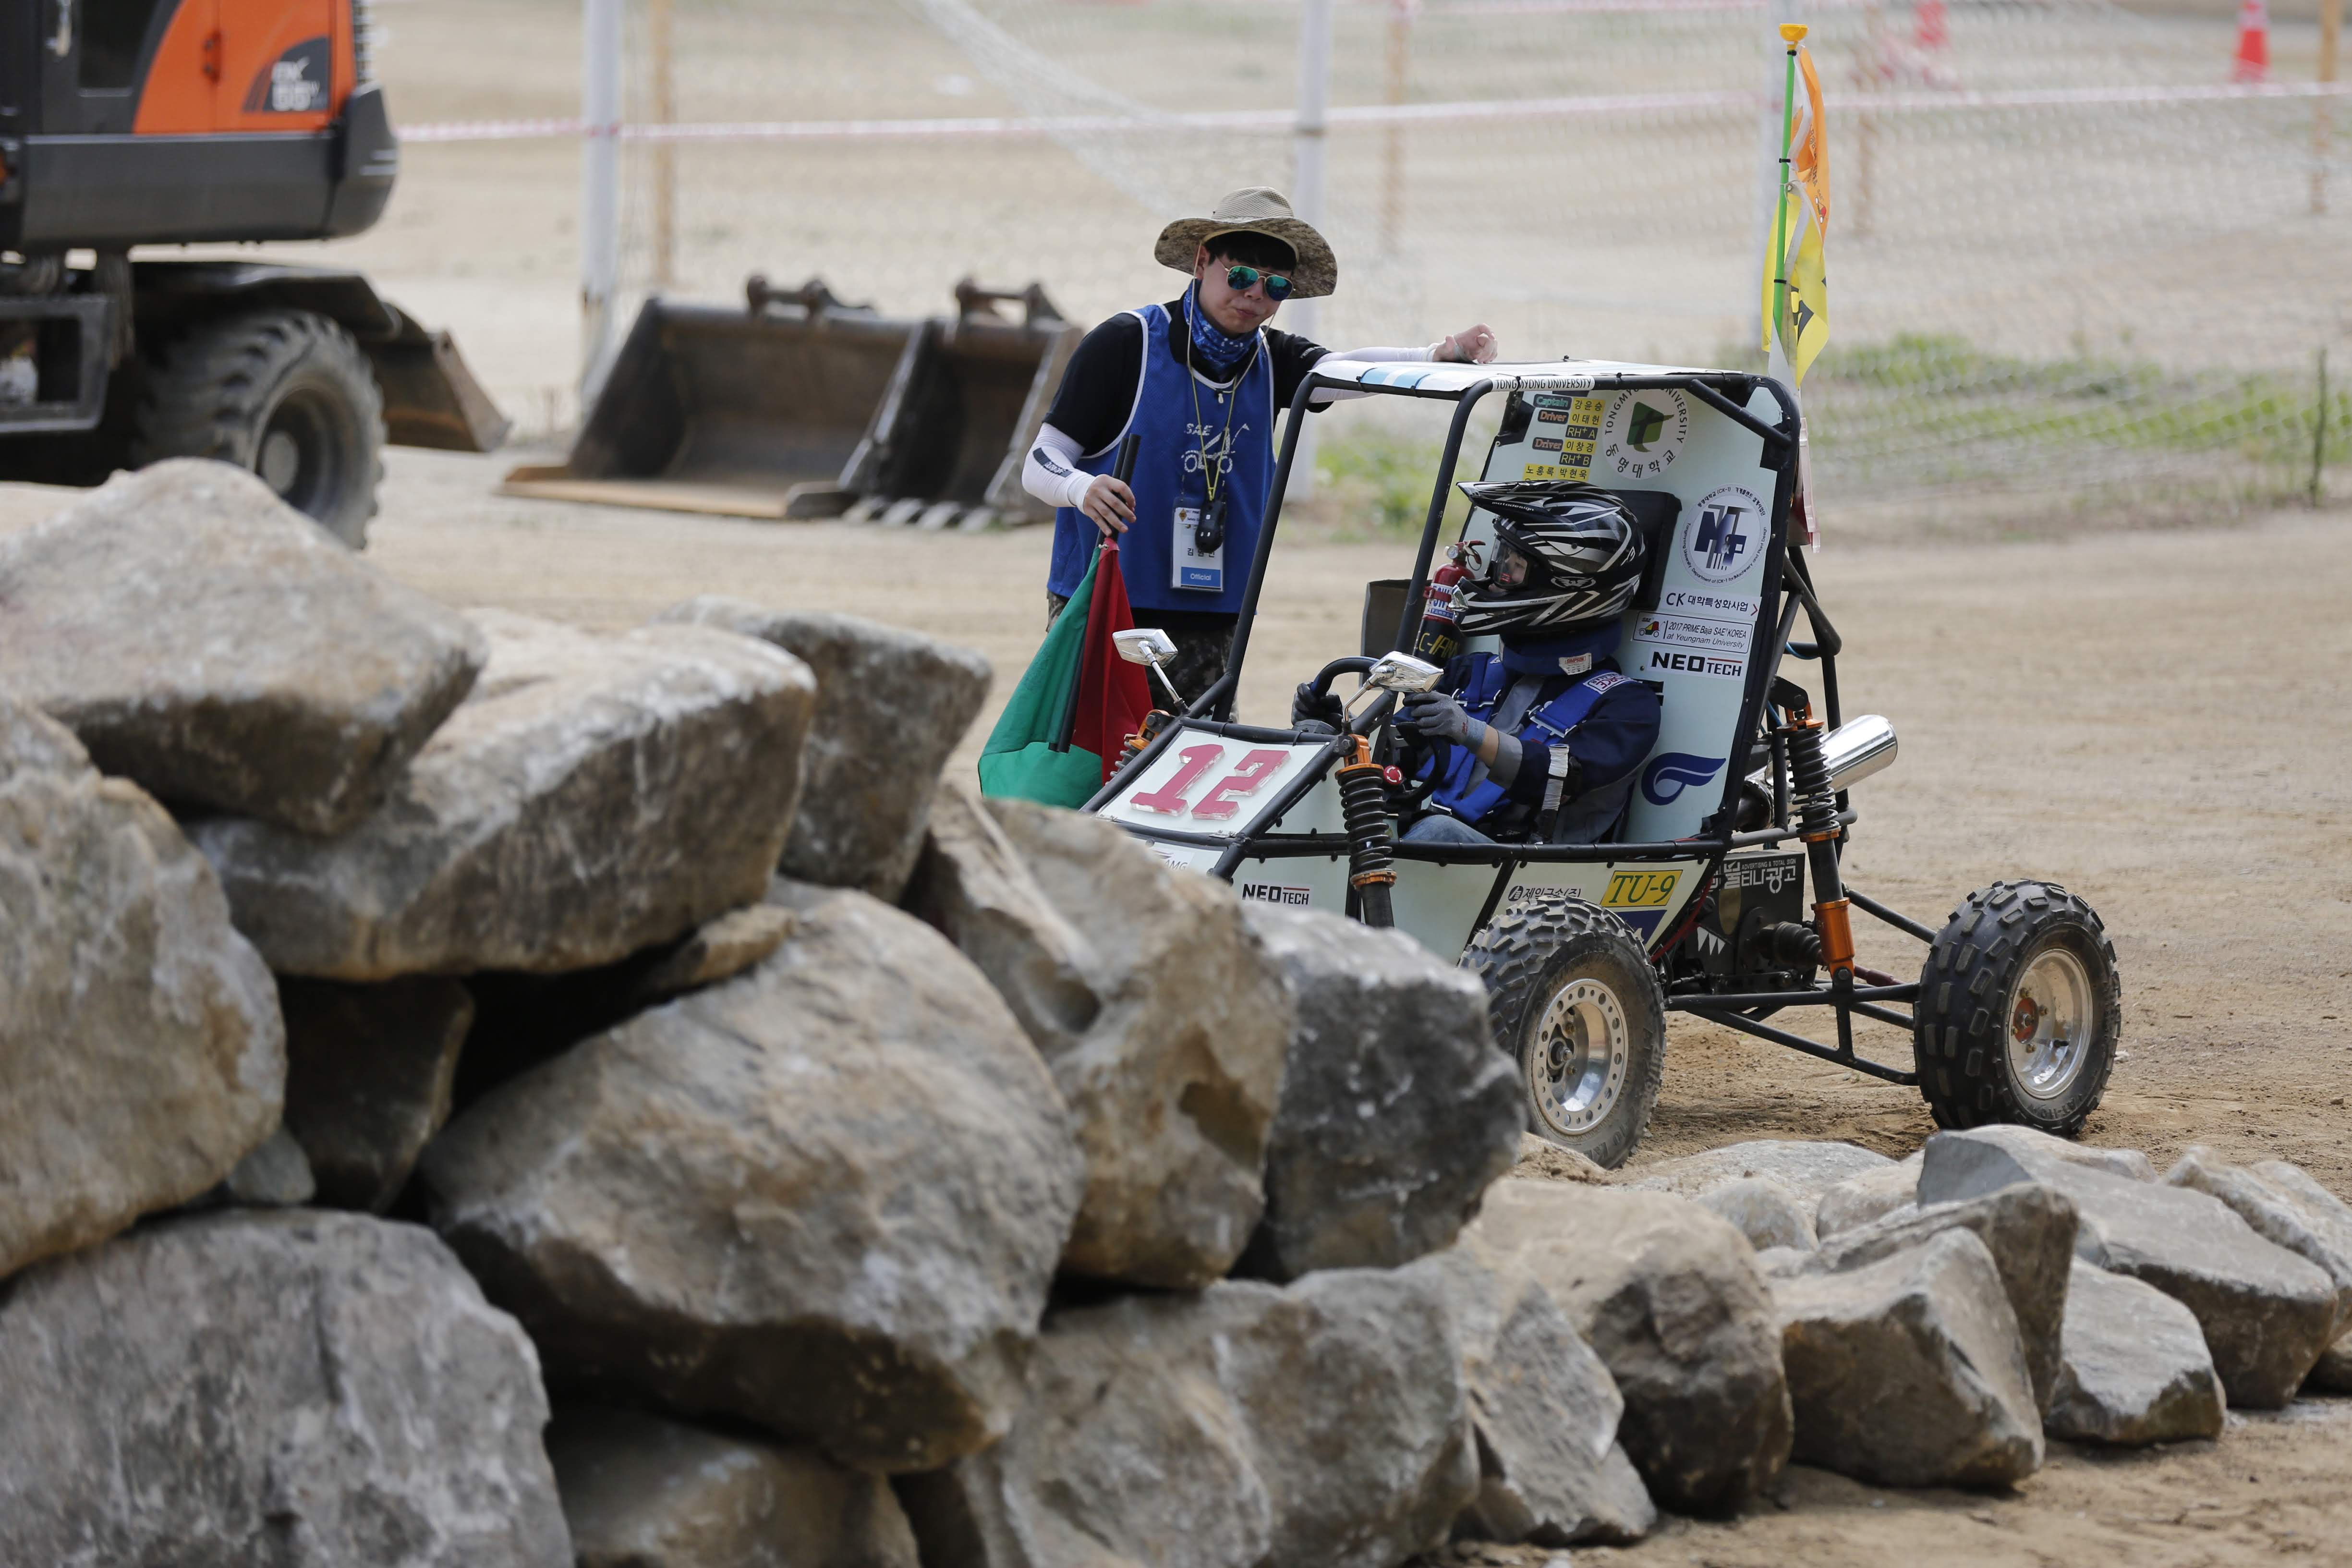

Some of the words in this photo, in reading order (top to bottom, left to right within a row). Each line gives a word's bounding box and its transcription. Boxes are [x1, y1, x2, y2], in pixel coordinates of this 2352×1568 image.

[1496, 378, 1545, 389] TONGMYONG
[1548, 378, 1591, 389] UNIVERSITY
[1536, 396, 1569, 408] Captain
[1540, 411, 1567, 422] Driver
[1661, 388, 1687, 443] NIVERSITY
[1186, 423, 1213, 436] SAE
[1588, 430, 1596, 439] A
[1535, 438, 1562, 450] Driver
[1583, 456, 1589, 465] B
[1606, 443, 1676, 478] 동명대학교
[1492, 501, 1534, 512] motodesign
[1190, 573, 1212, 581] Official
[1666, 593, 1686, 607] CK
[1687, 595, 1748, 612] 대학특성화사업
[1668, 622, 1682, 631] 2017
[1682, 623, 1700, 633] PRIME
[1700, 626, 1712, 635] Baja
[1727, 629, 1746, 639] KOREA
[1675, 634, 1710, 646] Yeungnam
[1712, 638, 1745, 649] University
[1130, 743, 1291, 820] 12
[1741, 862, 1768, 870] ADVERTISING
[1609, 875, 1676, 904] TU-9
